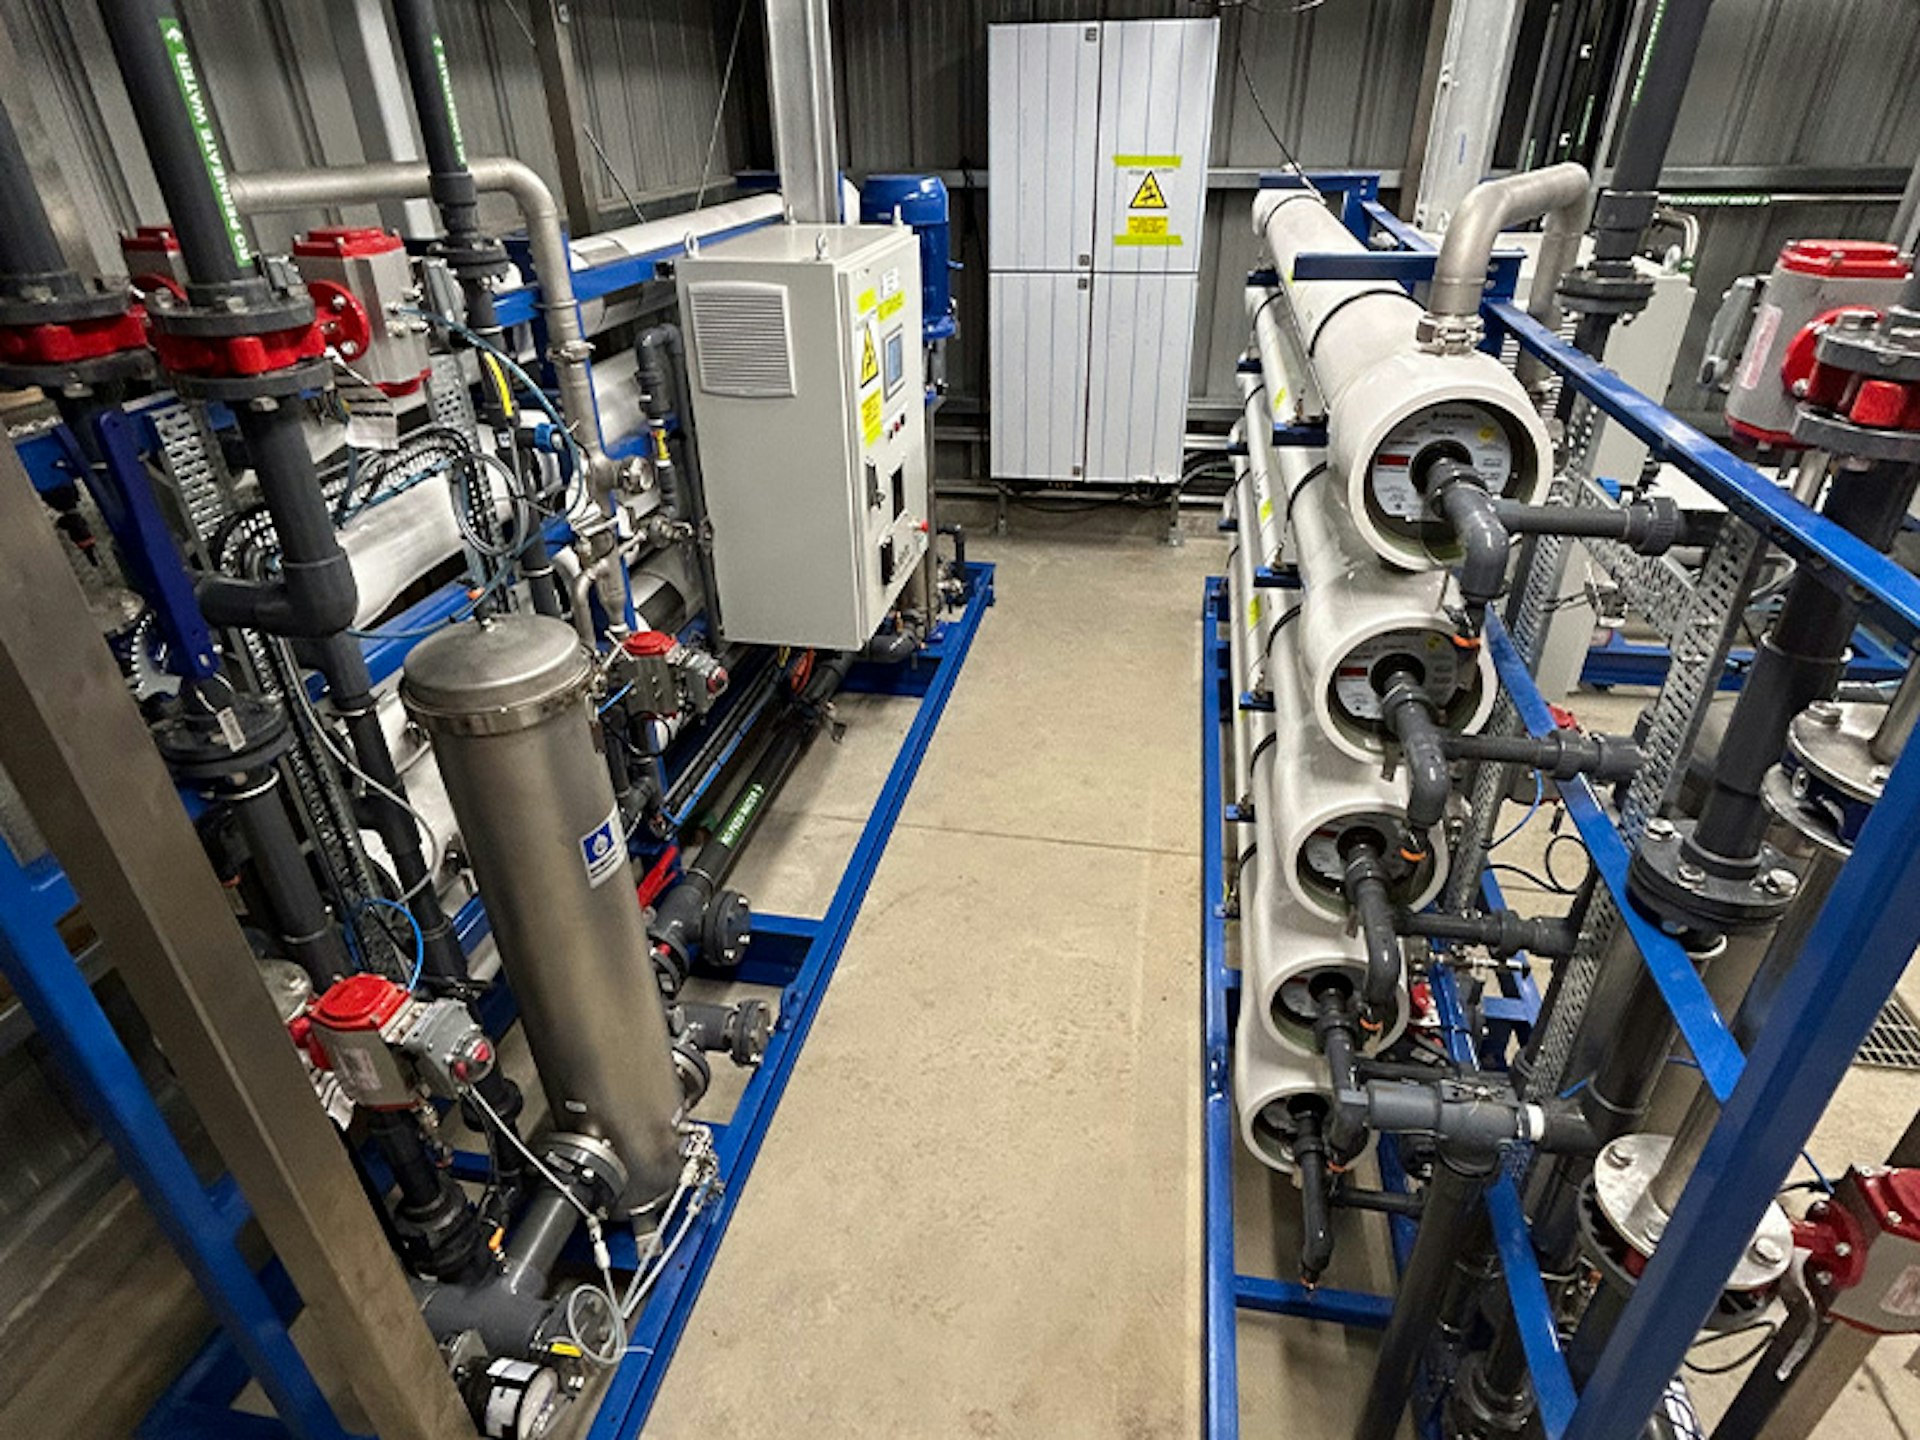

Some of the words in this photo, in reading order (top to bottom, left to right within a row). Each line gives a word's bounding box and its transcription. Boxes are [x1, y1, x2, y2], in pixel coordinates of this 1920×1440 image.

[175, 52, 208, 124] WATER
[200, 128, 241, 230] PERMEATE
[235, 234, 251, 261] RO
